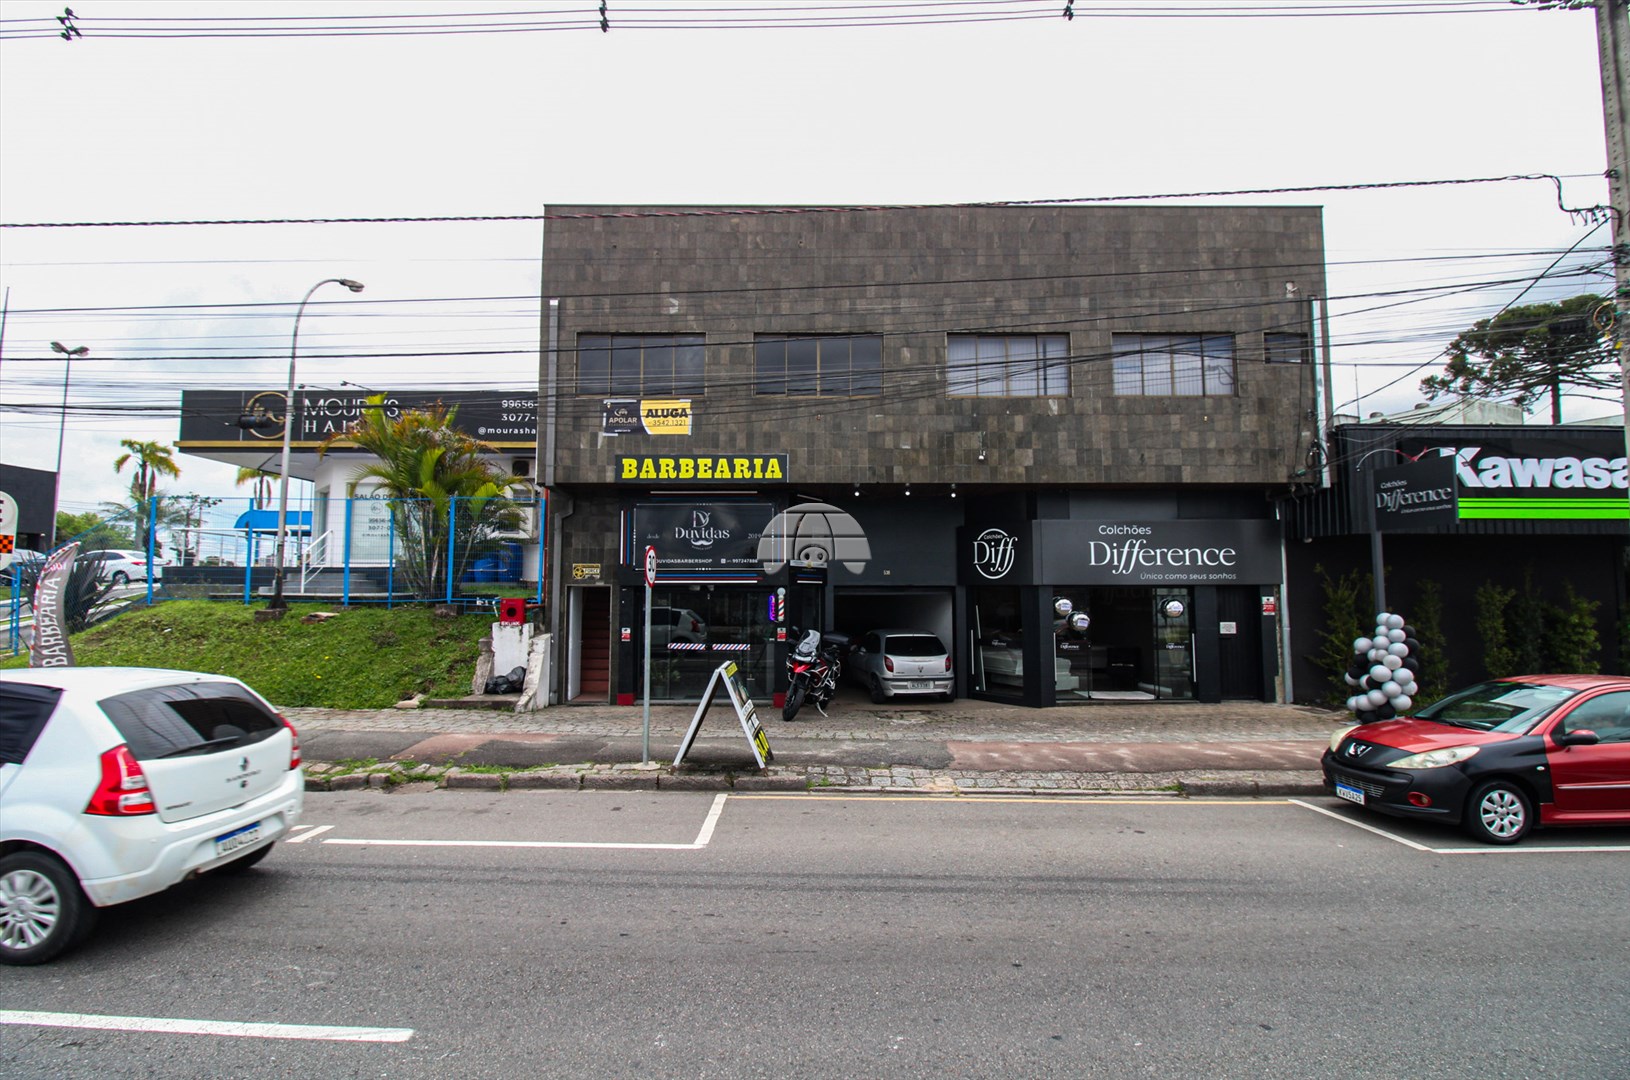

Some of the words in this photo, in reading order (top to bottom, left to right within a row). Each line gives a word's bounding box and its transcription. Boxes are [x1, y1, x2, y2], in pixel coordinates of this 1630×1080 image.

[501, 413, 538, 422] 3077-
[608, 416, 637, 424] APOLAR
[645, 408, 689, 419] ALUGA
[621, 458, 783, 479] BARBEARIA
[1376, 487, 1452, 512] Difference
[1098, 525, 1152, 535] Colchões
[973, 536, 1018, 572] Diff
[1088, 538, 1236, 575] Difference
[1140, 572, 1163, 580] Único
[40, 576, 69, 668] BARBEARIA
